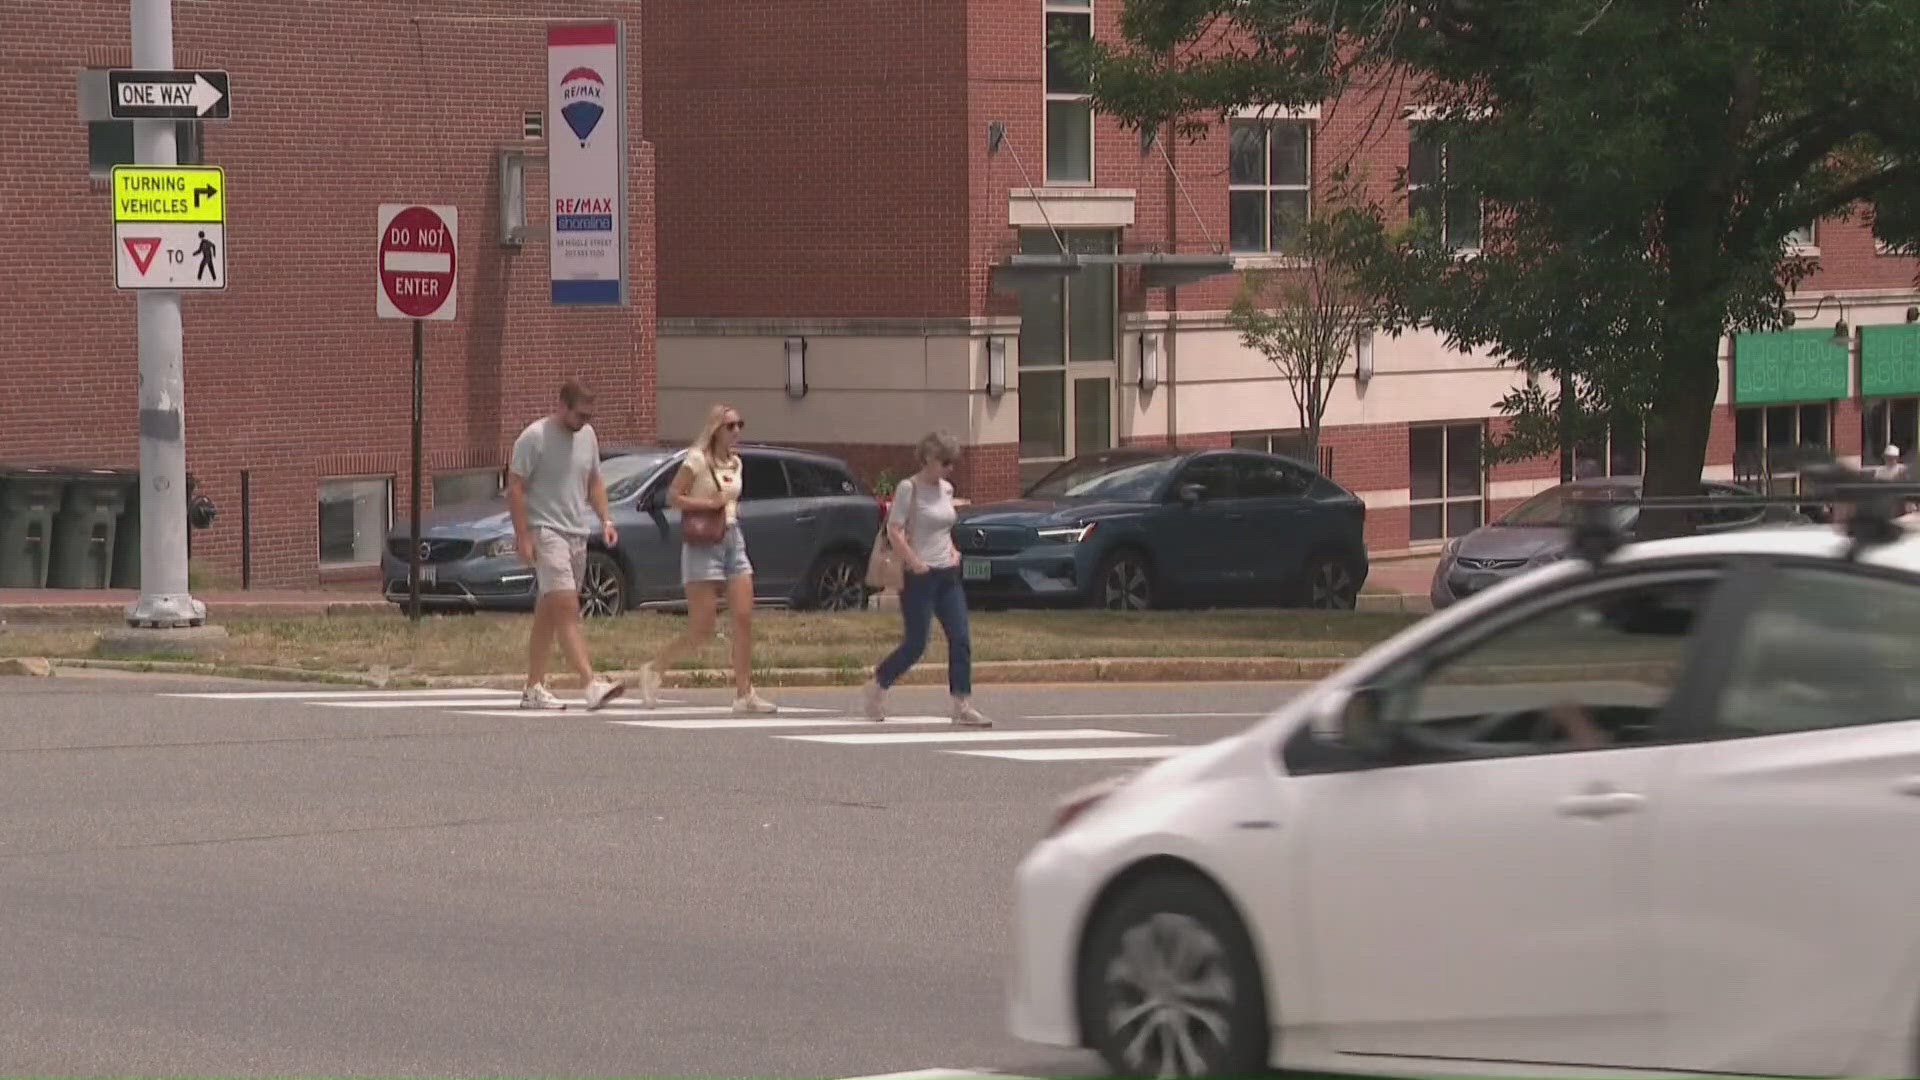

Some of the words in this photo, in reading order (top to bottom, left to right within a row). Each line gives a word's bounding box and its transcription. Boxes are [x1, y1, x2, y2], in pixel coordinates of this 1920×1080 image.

[123, 85, 155, 103] ONE
[160, 85, 192, 104] WAY
[564, 86, 601, 99] RE/MAX
[122, 176, 186, 191] TURNING
[121, 199, 188, 213] VEHICLES
[556, 198, 611, 213] RE/MAX
[391, 228, 410, 245] DO
[418, 228, 444, 247] NOT
[166, 249, 184, 264] TO
[395, 277, 438, 296] ENTER
